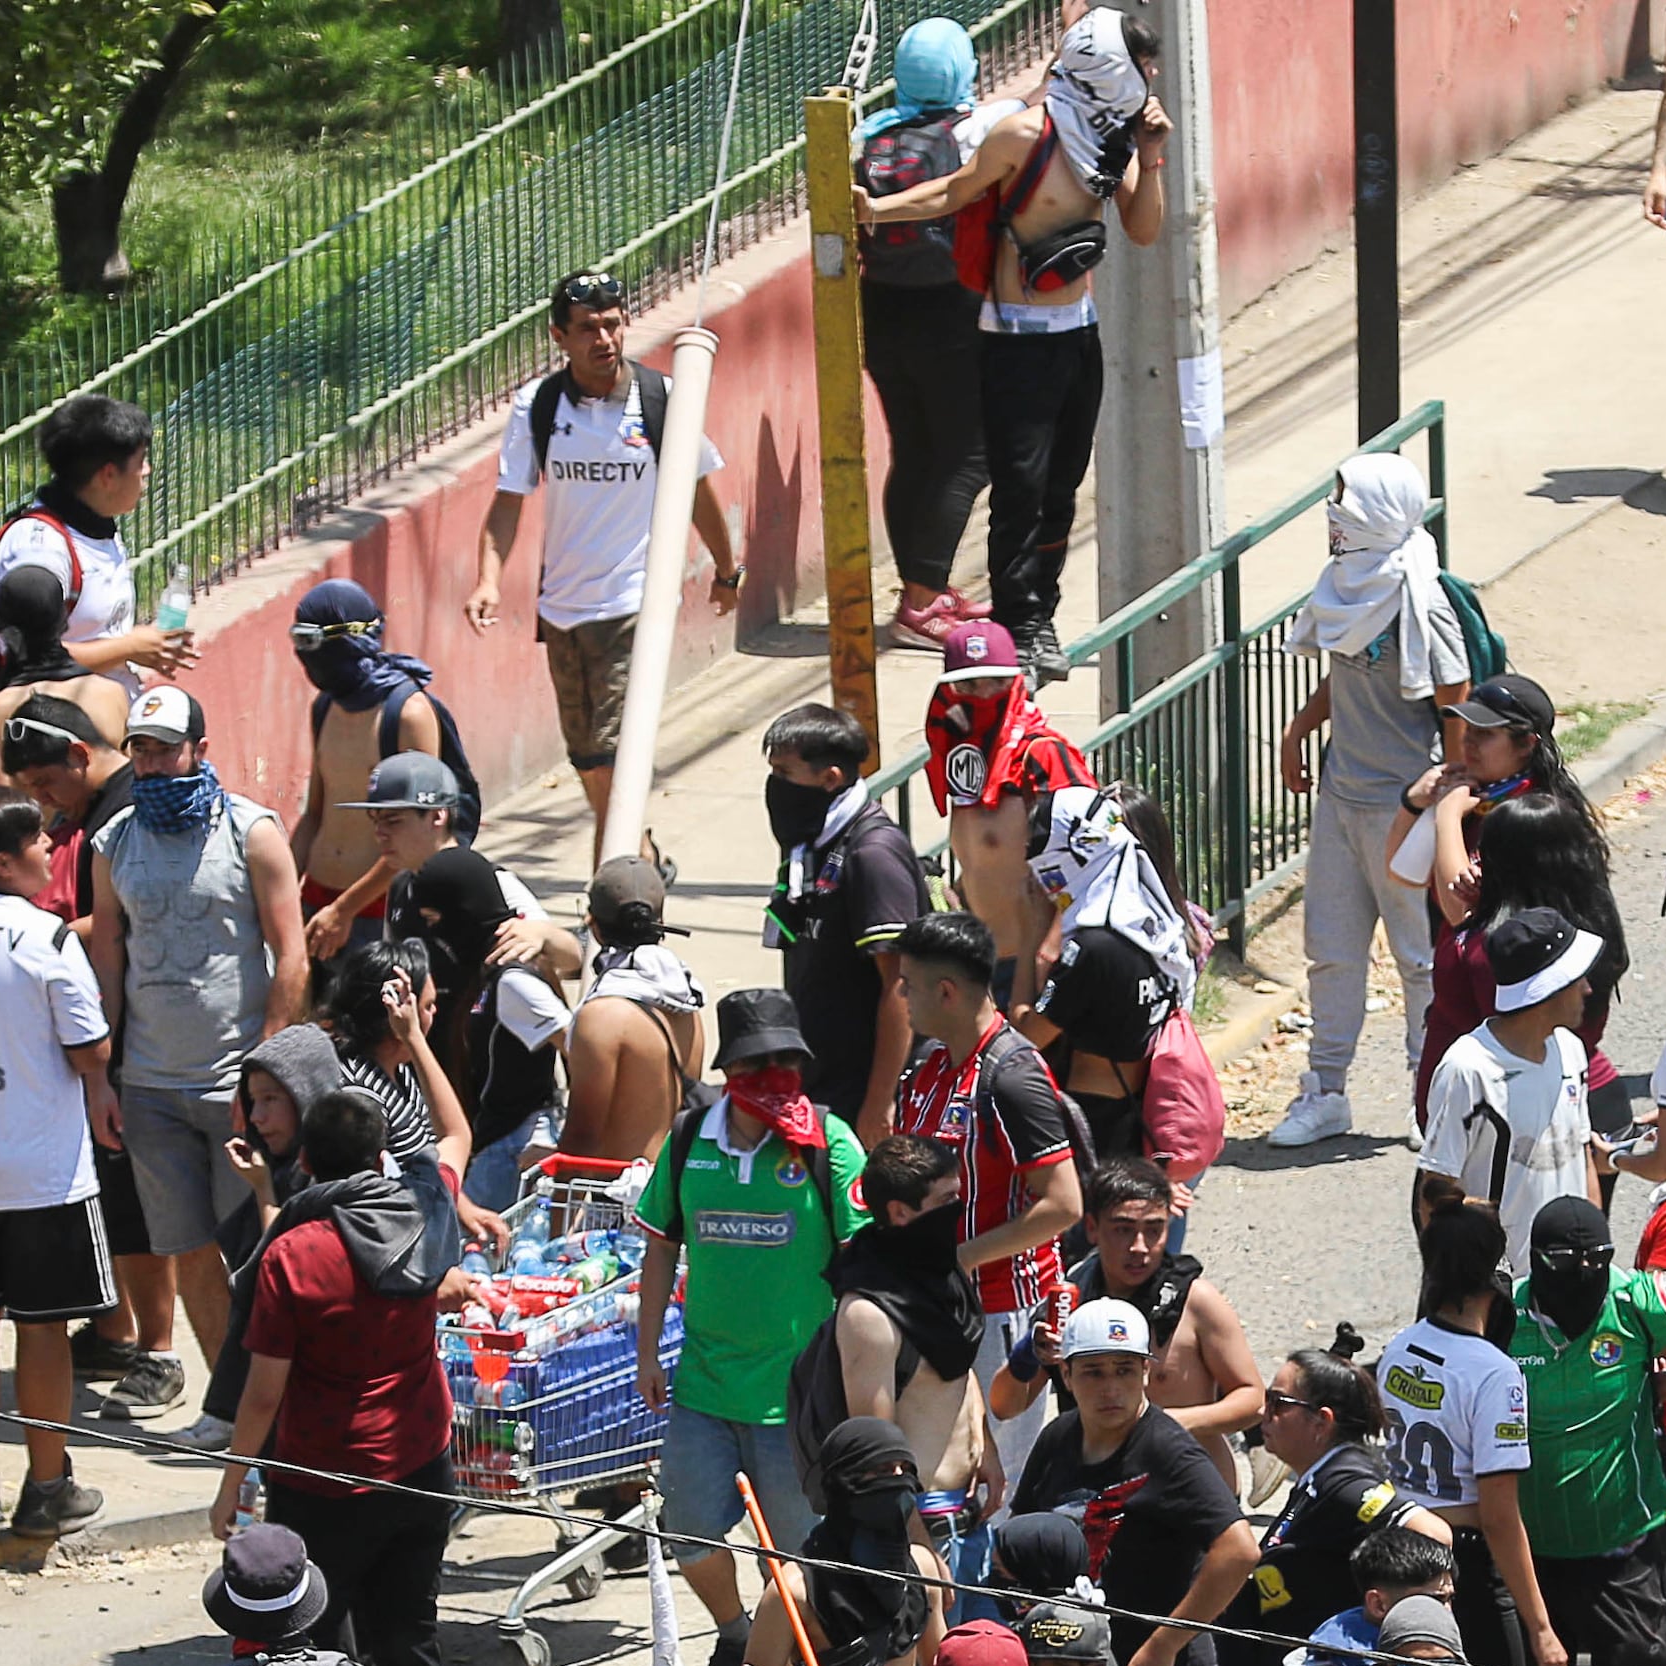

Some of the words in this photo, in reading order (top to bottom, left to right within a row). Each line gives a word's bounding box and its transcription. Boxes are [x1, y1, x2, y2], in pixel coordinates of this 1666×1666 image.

[552, 460, 647, 482] DIRECTV
[699, 1218, 789, 1238] TRAVERSO
[1390, 1374, 1438, 1404] CRISTAL
